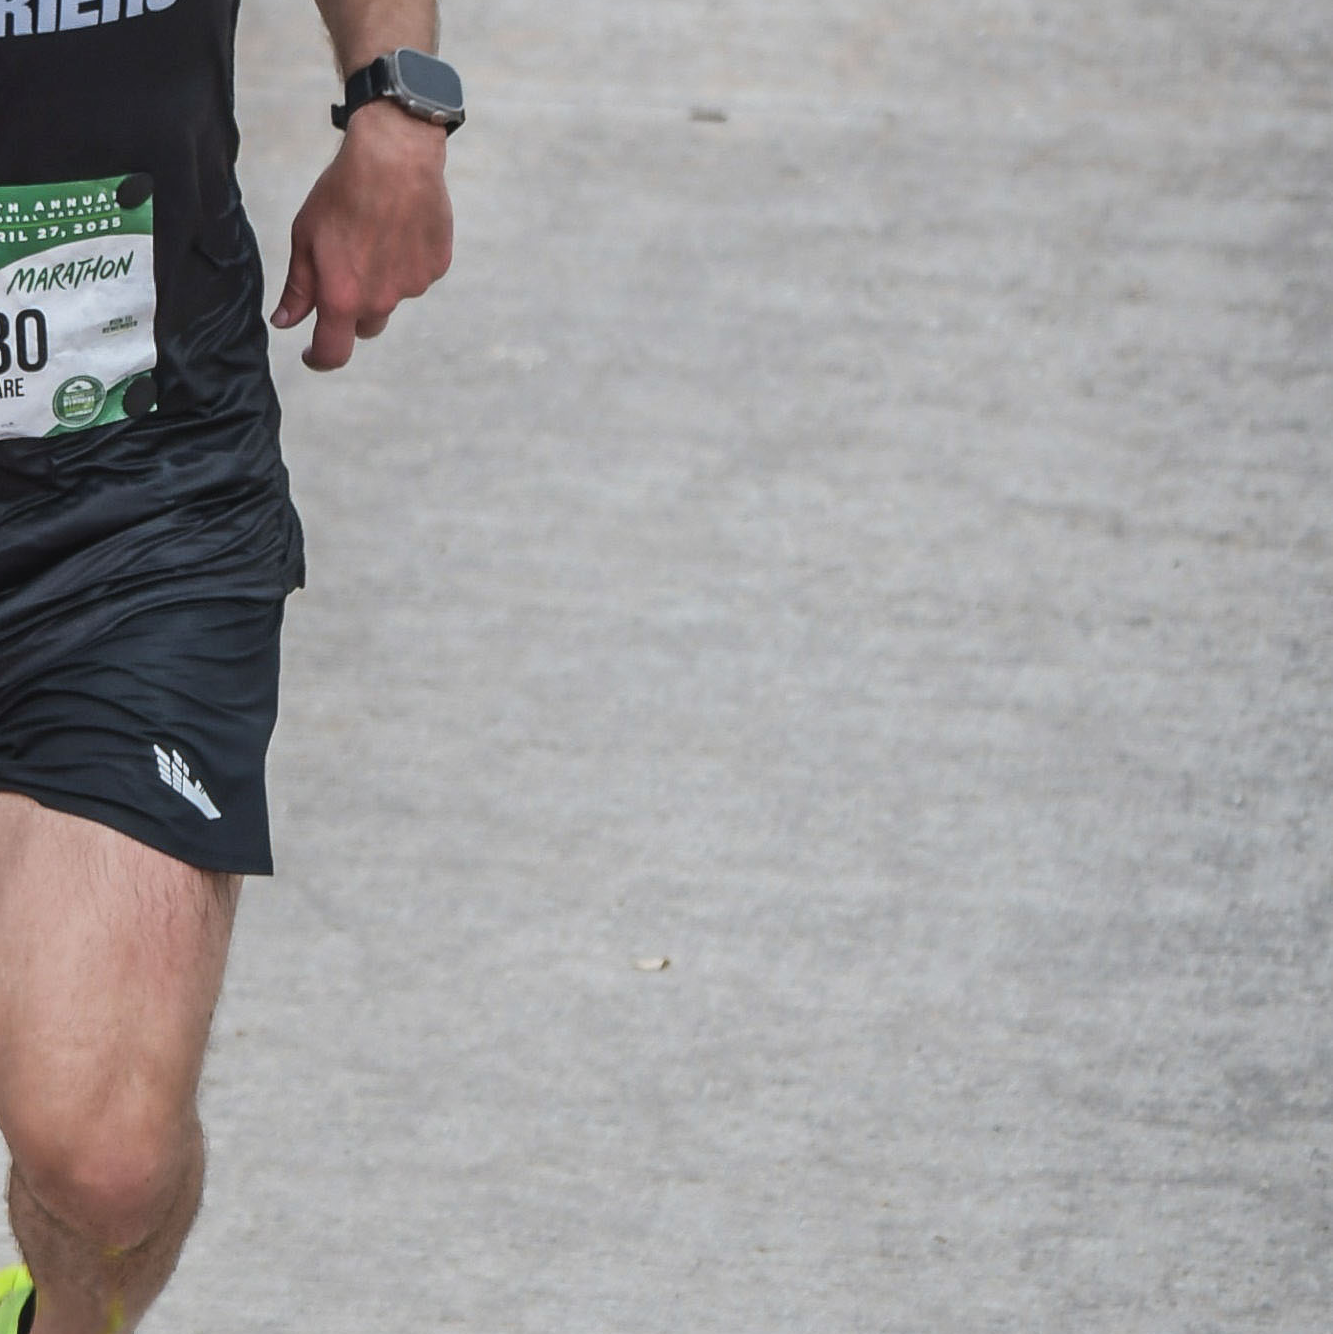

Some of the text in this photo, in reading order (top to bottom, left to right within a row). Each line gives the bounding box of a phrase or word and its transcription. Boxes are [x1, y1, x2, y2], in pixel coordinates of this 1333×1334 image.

[37, 225, 67, 240] 27,
[73, 216, 121, 235] 2025
[6, 250, 134, 296] MARATHON
